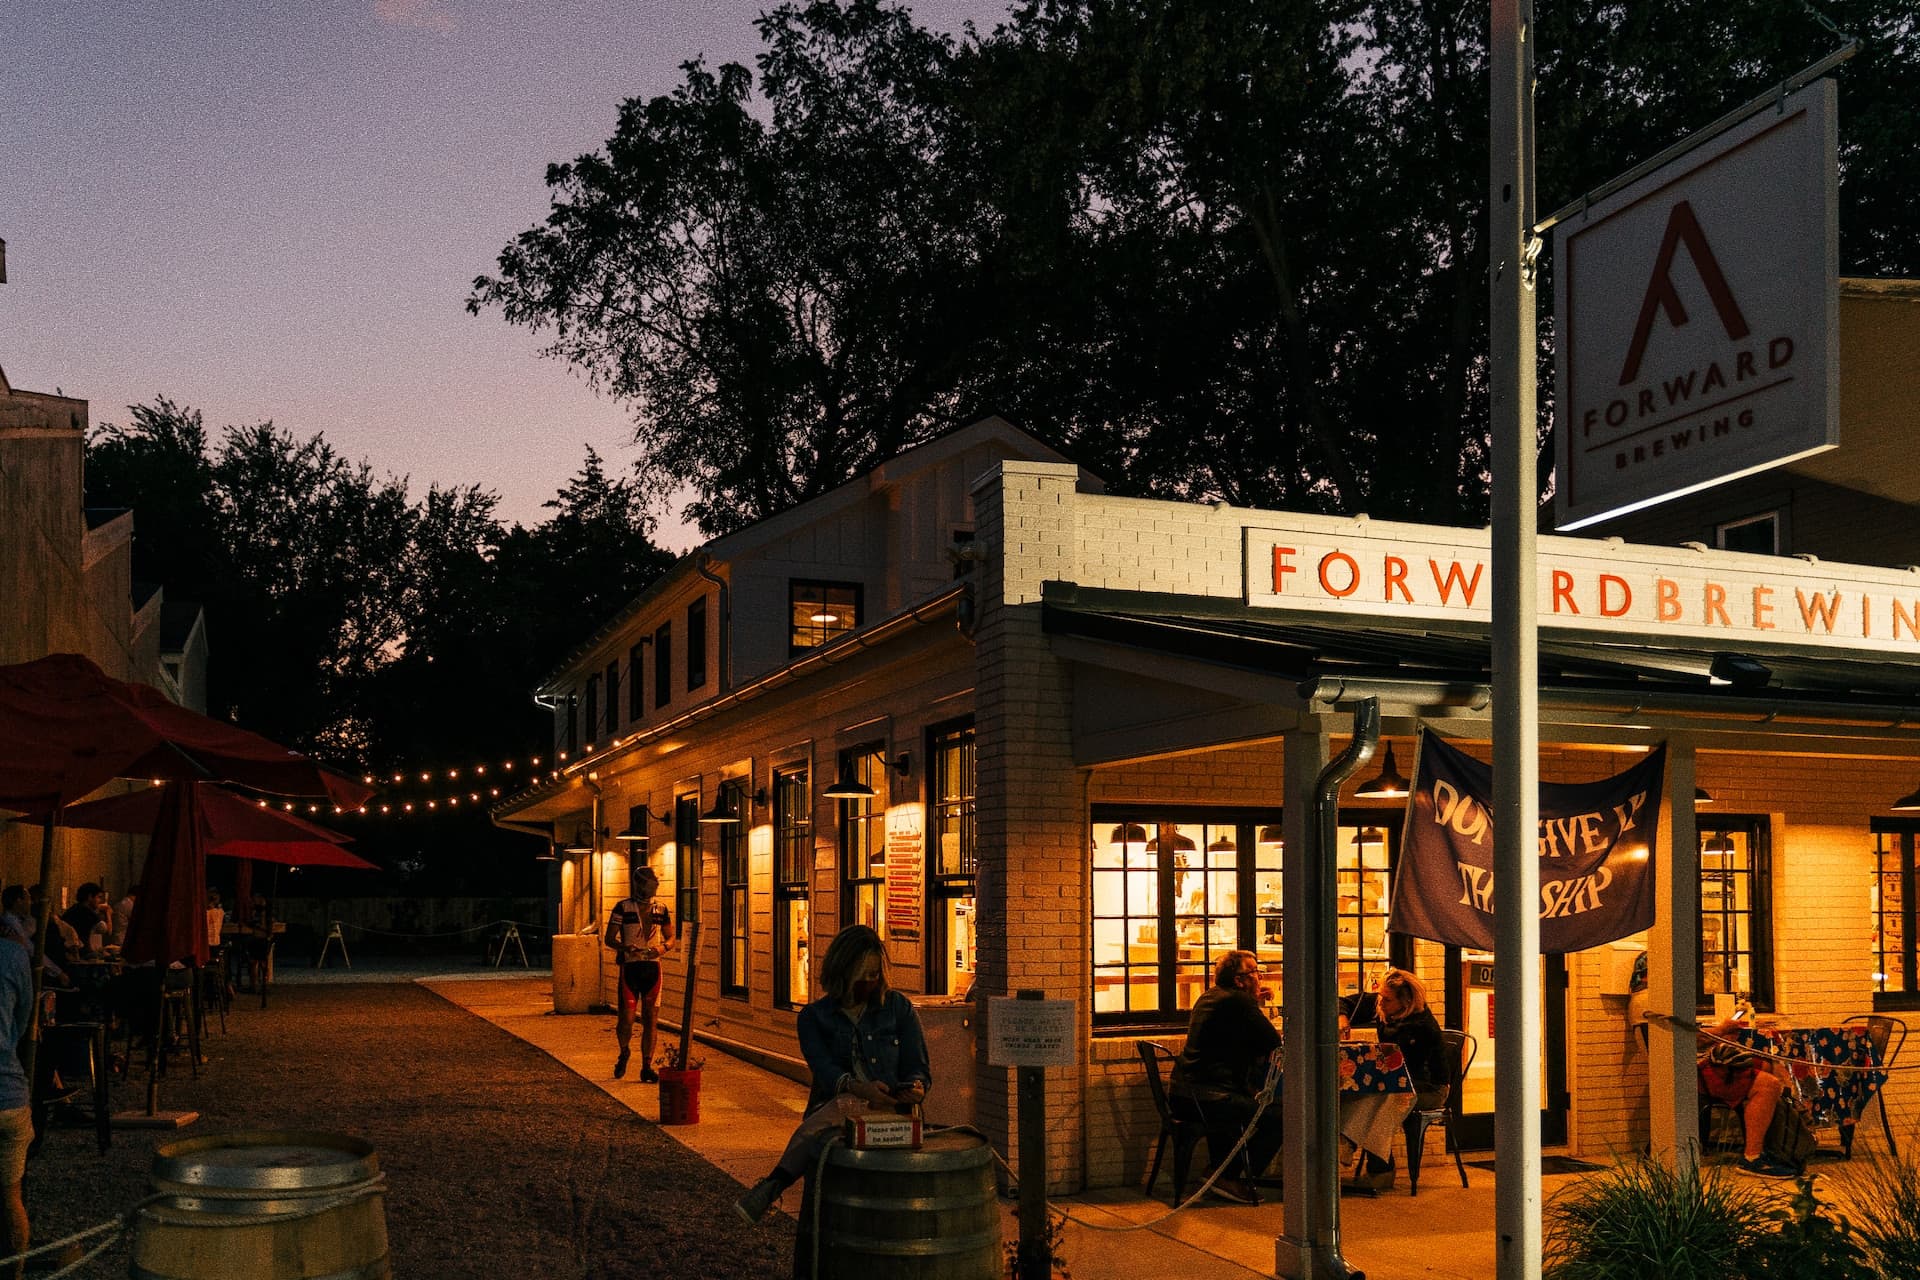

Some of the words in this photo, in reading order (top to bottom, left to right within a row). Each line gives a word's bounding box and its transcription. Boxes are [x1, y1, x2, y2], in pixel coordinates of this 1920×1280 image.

[1584, 337, 1794, 437] FORWARD
[1615, 409, 1754, 470] BREWING
[1272, 546, 1632, 617] FORWRD
[1538, 811, 1609, 858] IVE
[1457, 860, 1495, 915] TH
[1538, 866, 1613, 919] SHIP
